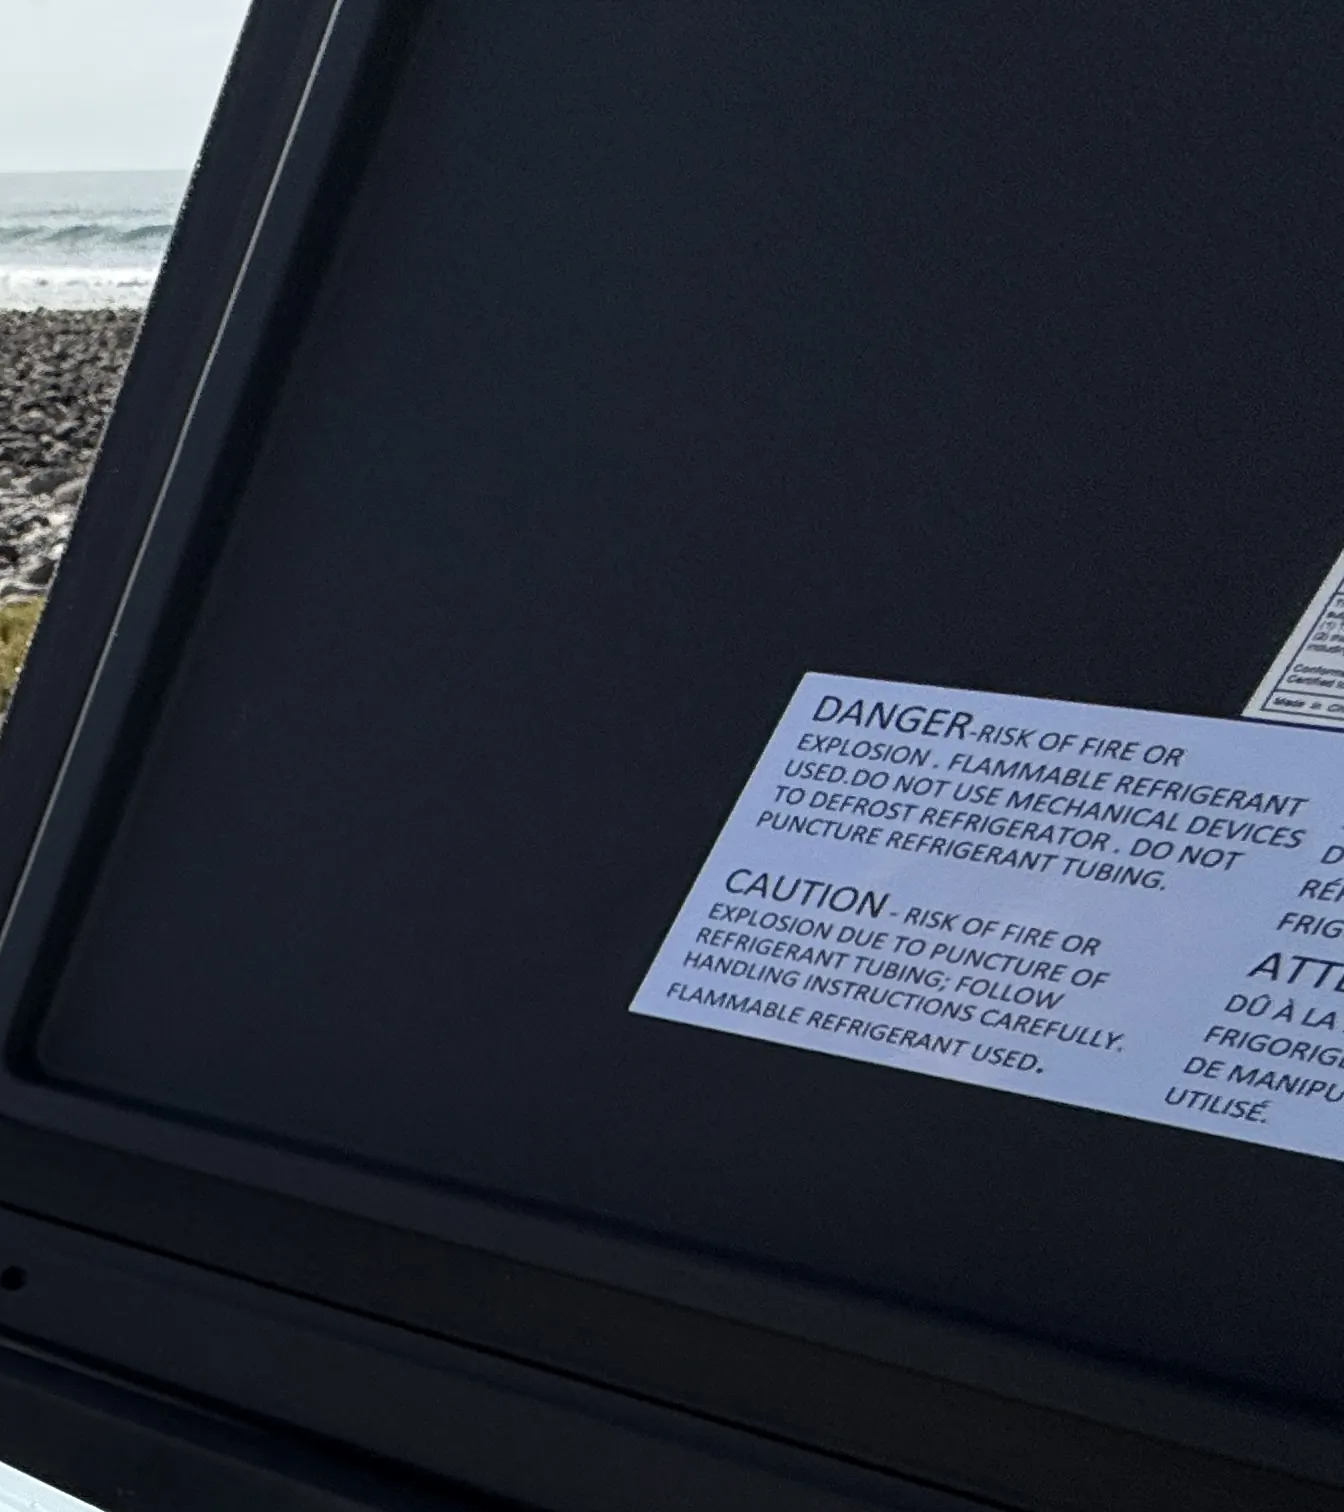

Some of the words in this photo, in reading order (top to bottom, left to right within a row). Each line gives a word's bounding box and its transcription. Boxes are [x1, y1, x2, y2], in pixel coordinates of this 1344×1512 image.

[948, 753, 1113, 791] FLAMMABLE
[1114, 775, 1309, 817] REFRIGERANT
[1039, 732, 1078, 753] OF
[1079, 737, 1141, 761] FIRE
[1143, 745, 1185, 767] OR
[756, 810, 884, 846] PUNCTURE
[885, 831, 1059, 873] REFRIGERANT
[1062, 856, 1166, 890] TUBING.
[774, 785, 805, 805] TO
[809, 790, 919, 822] DEFROST
[1129, 838, 1174, 860] DO
[1177, 845, 1246, 872] NOT
[892, 775, 952, 799] NOT
[953, 783, 1004, 807] USE
[1005, 790, 1181, 832] MECHANICAL
[1185, 815, 1307, 849] DEVICES
[709, 902, 833, 941] EXPLOSION
[836, 926, 889, 950] DUE
[893, 935, 926, 957] TO
[930, 942, 1067, 983] PUNCTURE
[1070, 968, 1110, 990] OF
[725, 868, 890, 919] CAUTION
[903, 907, 960, 932] RISK
[962, 917, 1000, 938] OF
[1000, 923, 1059, 949] FIRE
[1061, 934, 1101, 957] OR
[682, 950, 800, 988] HANDLING
[803, 974, 976, 1022] INSTRUCTIONS
[980, 1008, 1124, 1052] CAREFULLY.
[696, 927, 849, 969] REFRIGERANT
[852, 955, 951, 993] TUBING;
[954, 975, 1066, 1010] FOLLOW
[666, 982, 805, 1024] FLAMMABLE
[806, 1010, 970, 1056] REFRIGERANT
[971, 1043, 1044, 1074] USED.
[1271, 998, 1294, 1023] À
[1300, 1007, 1336, 1030] LA
[1164, 1086, 1272, 1123] UTILISÉ.
[1184, 1057, 1226, 1078] DE
